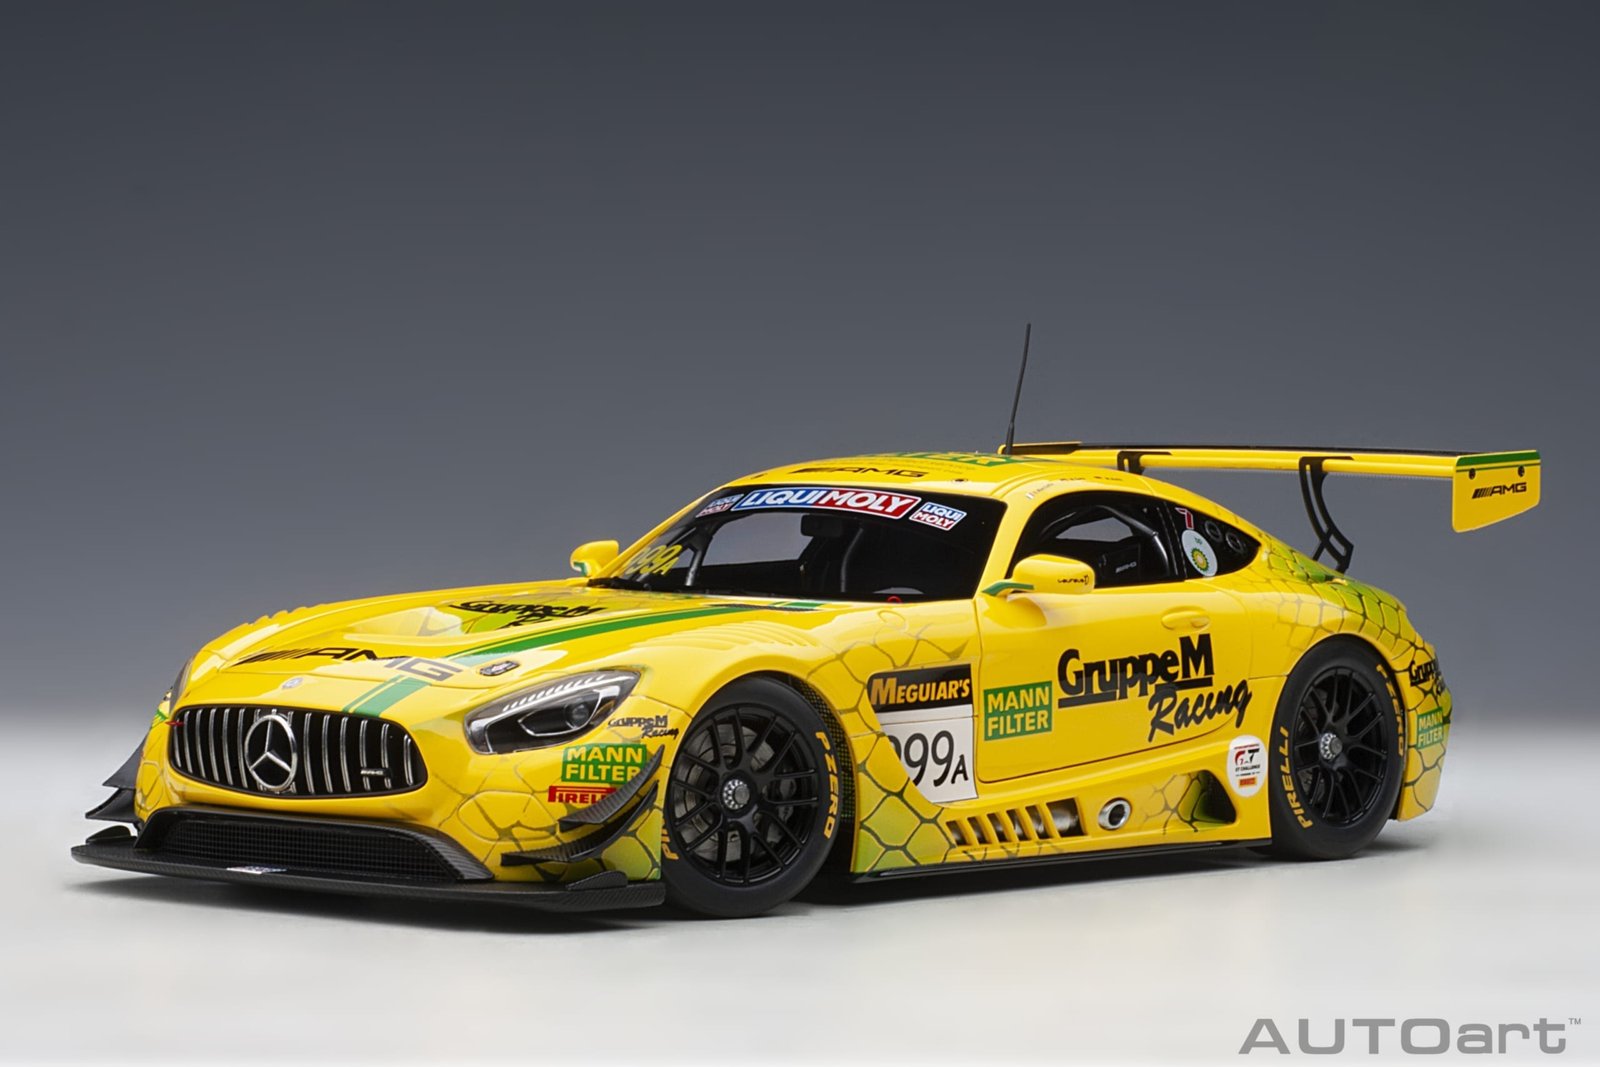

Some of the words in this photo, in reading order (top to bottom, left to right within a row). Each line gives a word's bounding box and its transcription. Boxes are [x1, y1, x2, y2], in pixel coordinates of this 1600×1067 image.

[1489, 481, 1527, 496] AMG
[914, 512, 954, 528] MOLY
[922, 504, 962, 520] LIQUI
[289, 647, 464, 682] AMG
[1058, 633, 1214, 702] GruppeM
[870, 677, 970, 705] MEGUIAR'S
[987, 688, 1050, 713] MANN
[1148, 680, 1252, 742] Racing
[987, 713, 1050, 737] FILTER
[567, 747, 643, 763] MANN
[815, 731, 831, 751] P
[823, 752, 840, 839] ZERO
[1279, 726, 1314, 829] PIRELLI
[547, 785, 617, 804] PIREL
